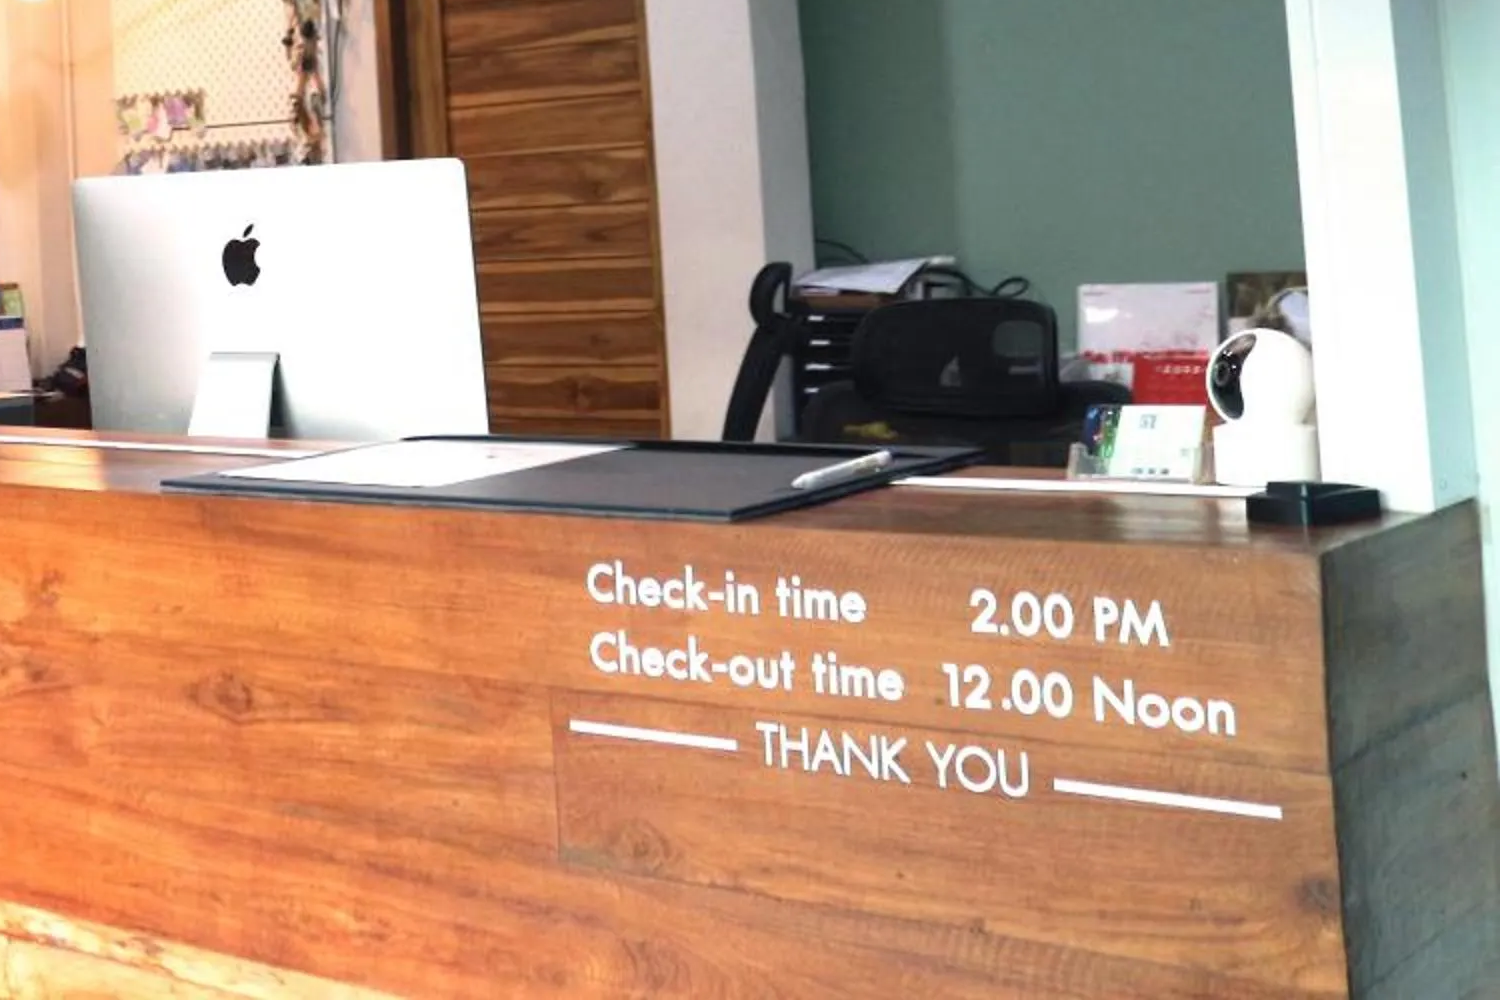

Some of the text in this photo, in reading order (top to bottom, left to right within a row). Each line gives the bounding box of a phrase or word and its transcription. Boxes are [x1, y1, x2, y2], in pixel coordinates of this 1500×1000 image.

[586, 559, 1172, 648] Check-in time 2.00 PM
[589, 629, 1237, 737] Check-out time 12.00 Noon
[755, 720, 1030, 798] THANK YOU
